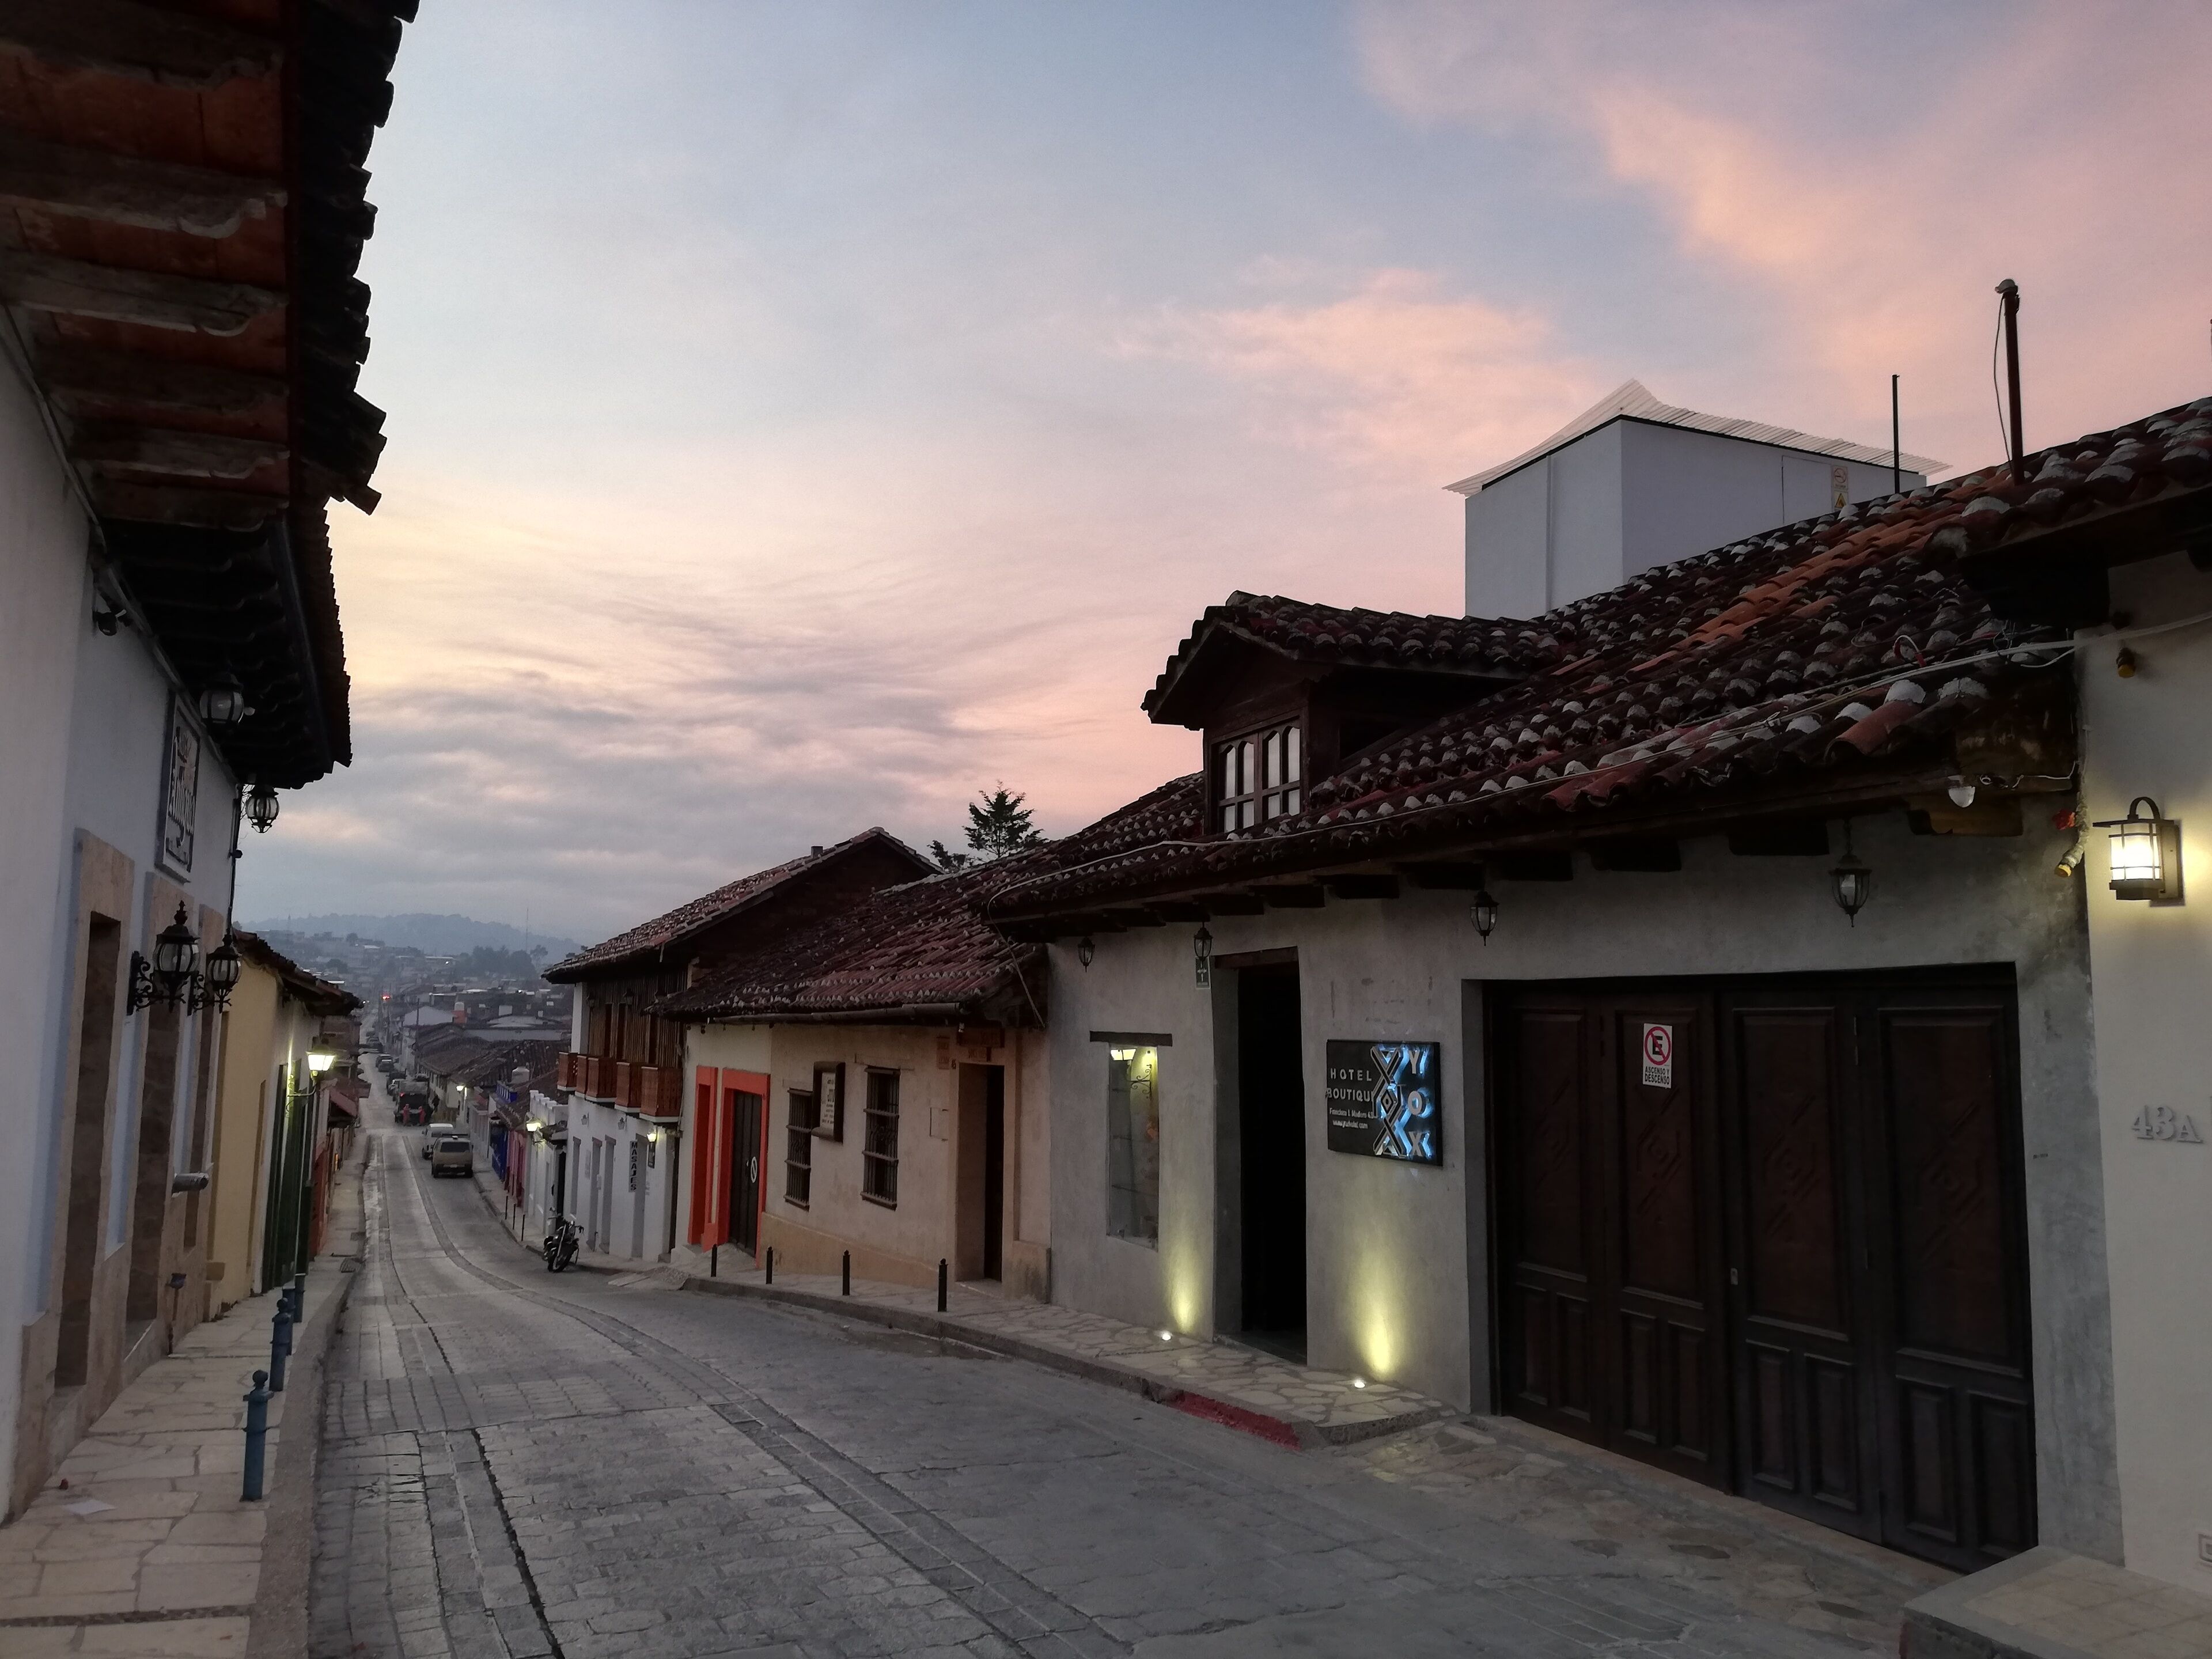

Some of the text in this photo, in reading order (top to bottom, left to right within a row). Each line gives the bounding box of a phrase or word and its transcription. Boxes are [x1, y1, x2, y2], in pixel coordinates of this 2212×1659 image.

[1652, 1035, 1663, 1055] E
[1330, 1068, 1372, 1081] HOTEL
[1645, 1066, 1665, 1075] ASCENSO
[1645, 1073, 1670, 1085] DESCENSO
[2131, 1104, 2203, 1143] 43A
